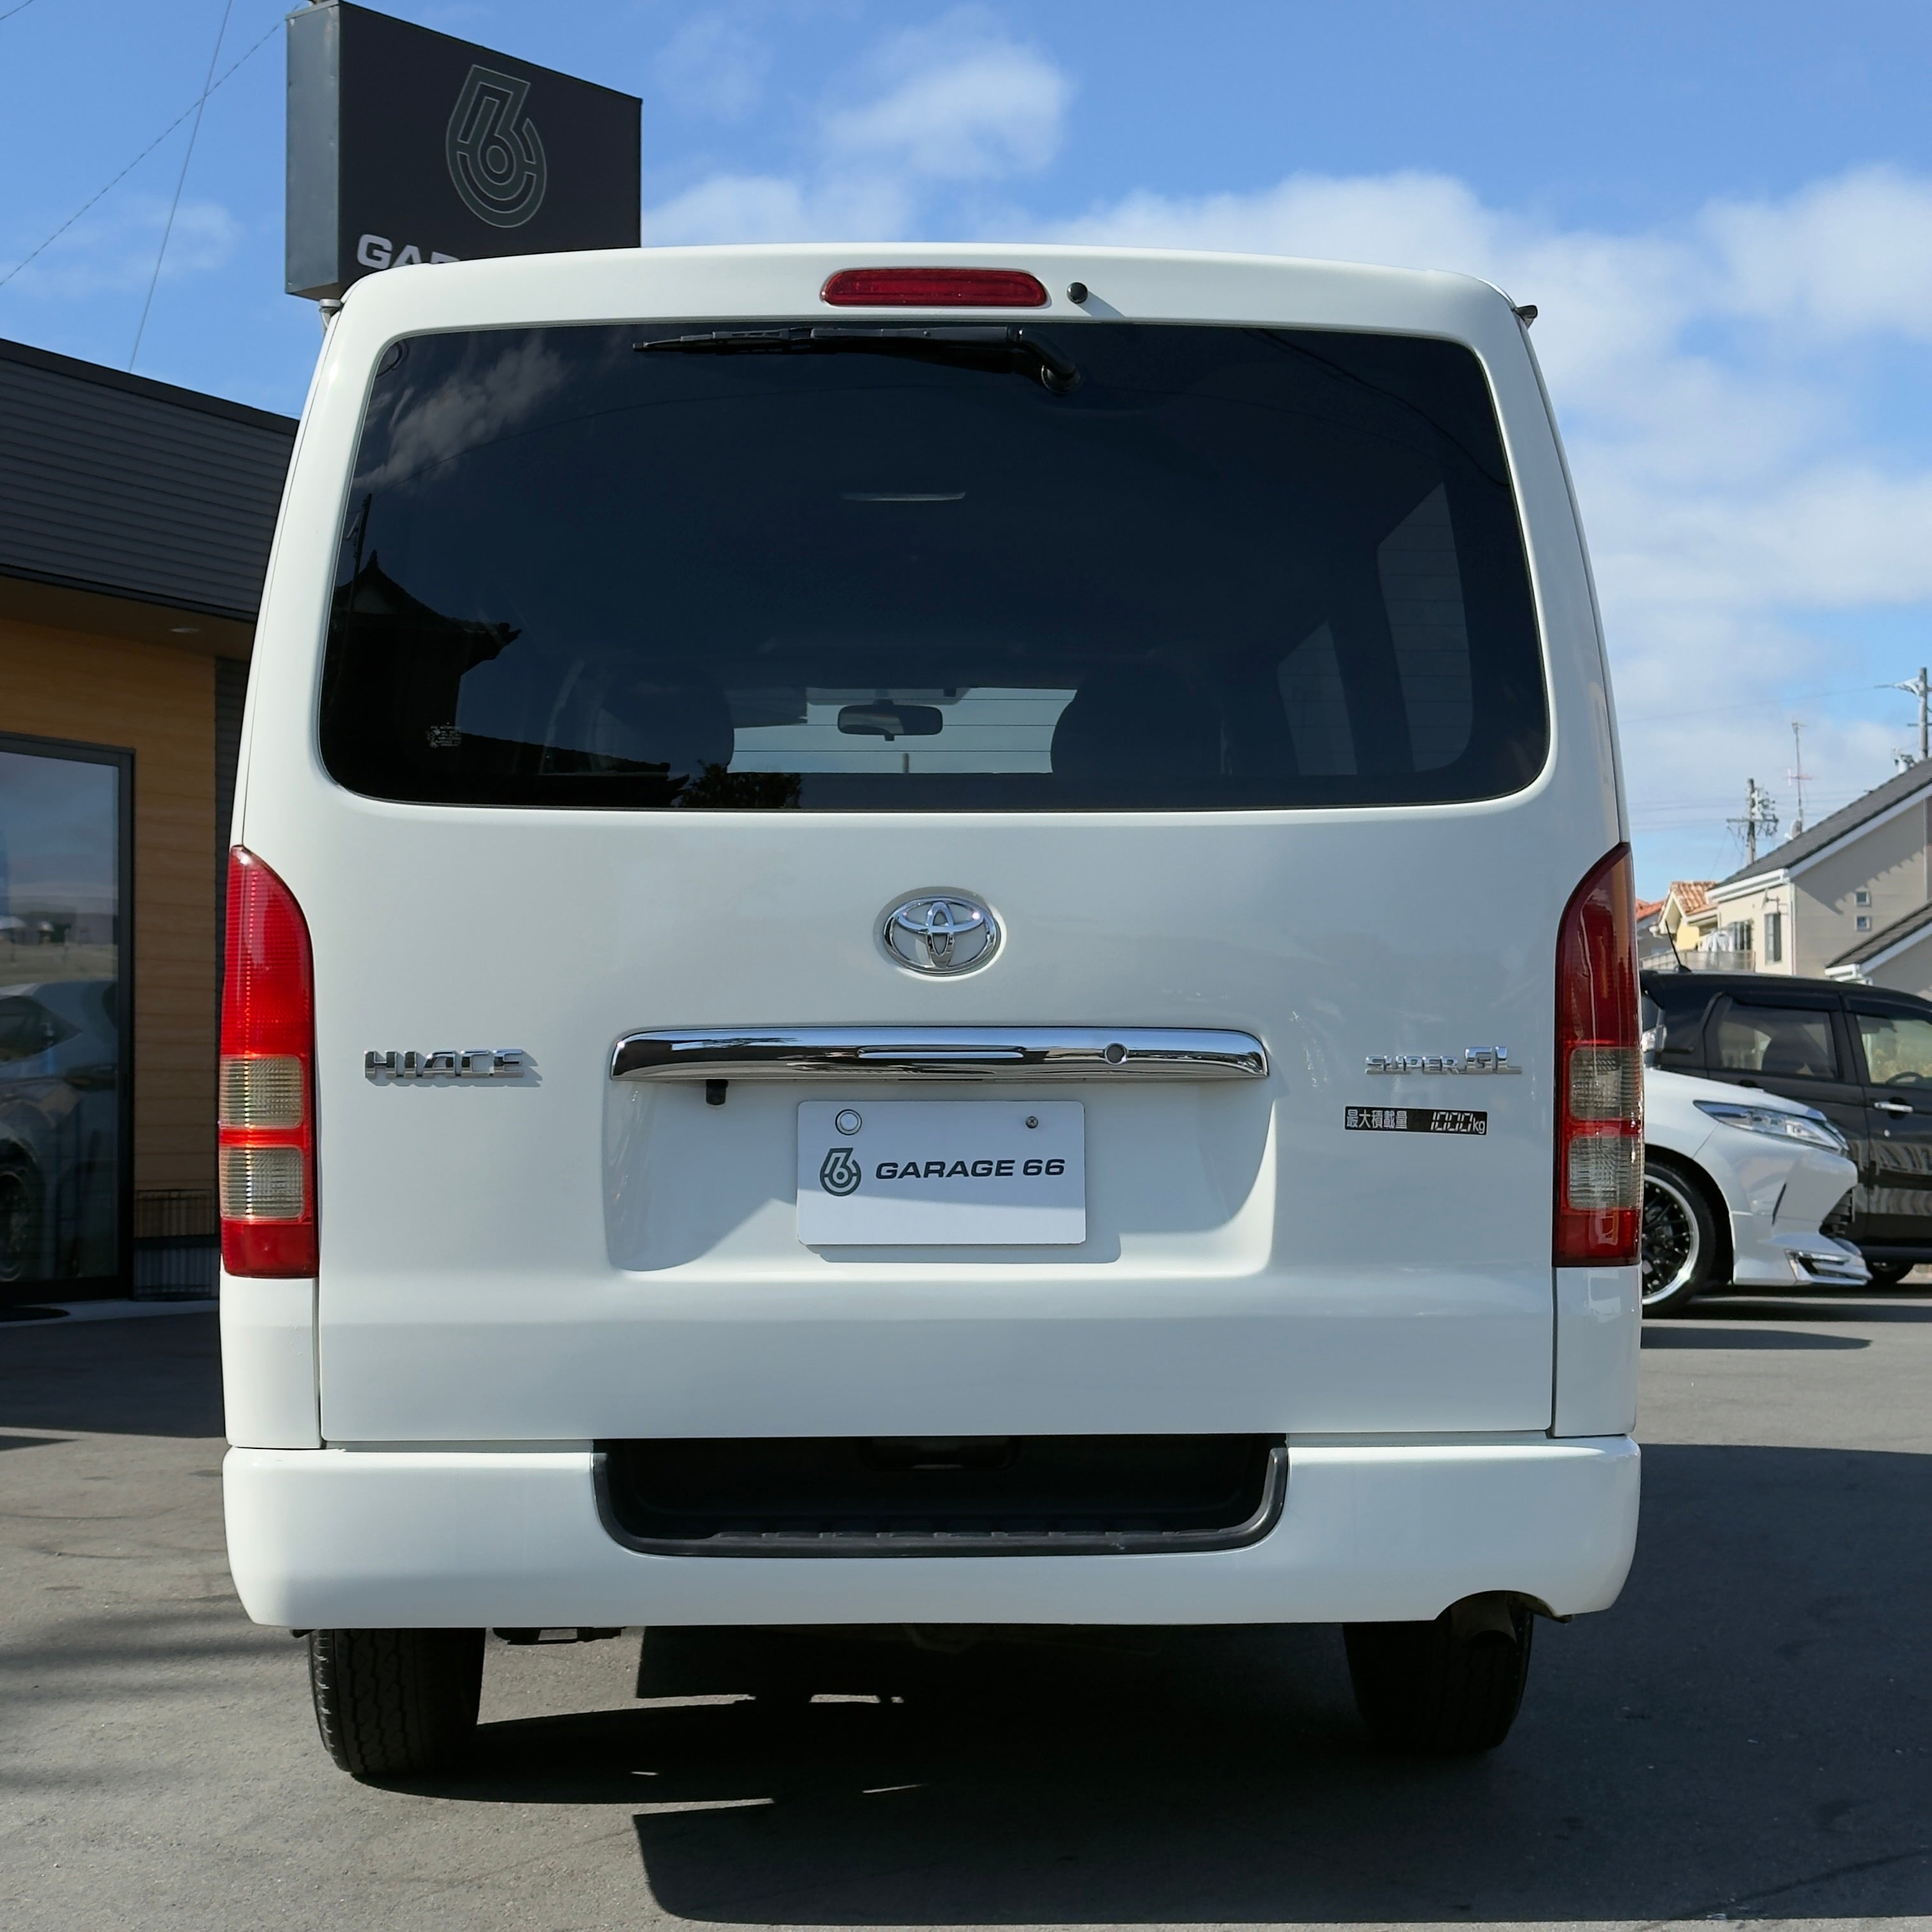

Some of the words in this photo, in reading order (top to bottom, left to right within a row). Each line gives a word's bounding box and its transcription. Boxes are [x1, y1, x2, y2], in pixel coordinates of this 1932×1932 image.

[364, 1049, 524, 1078] HIACE
[1365, 1055, 1460, 1075] SUPER
[1465, 1046, 1522, 1074] GL
[1346, 1108, 1407, 1130] 最大積載量
[876, 1160, 1015, 1179] GARAGE
[1023, 1159, 1065, 1176] 66
